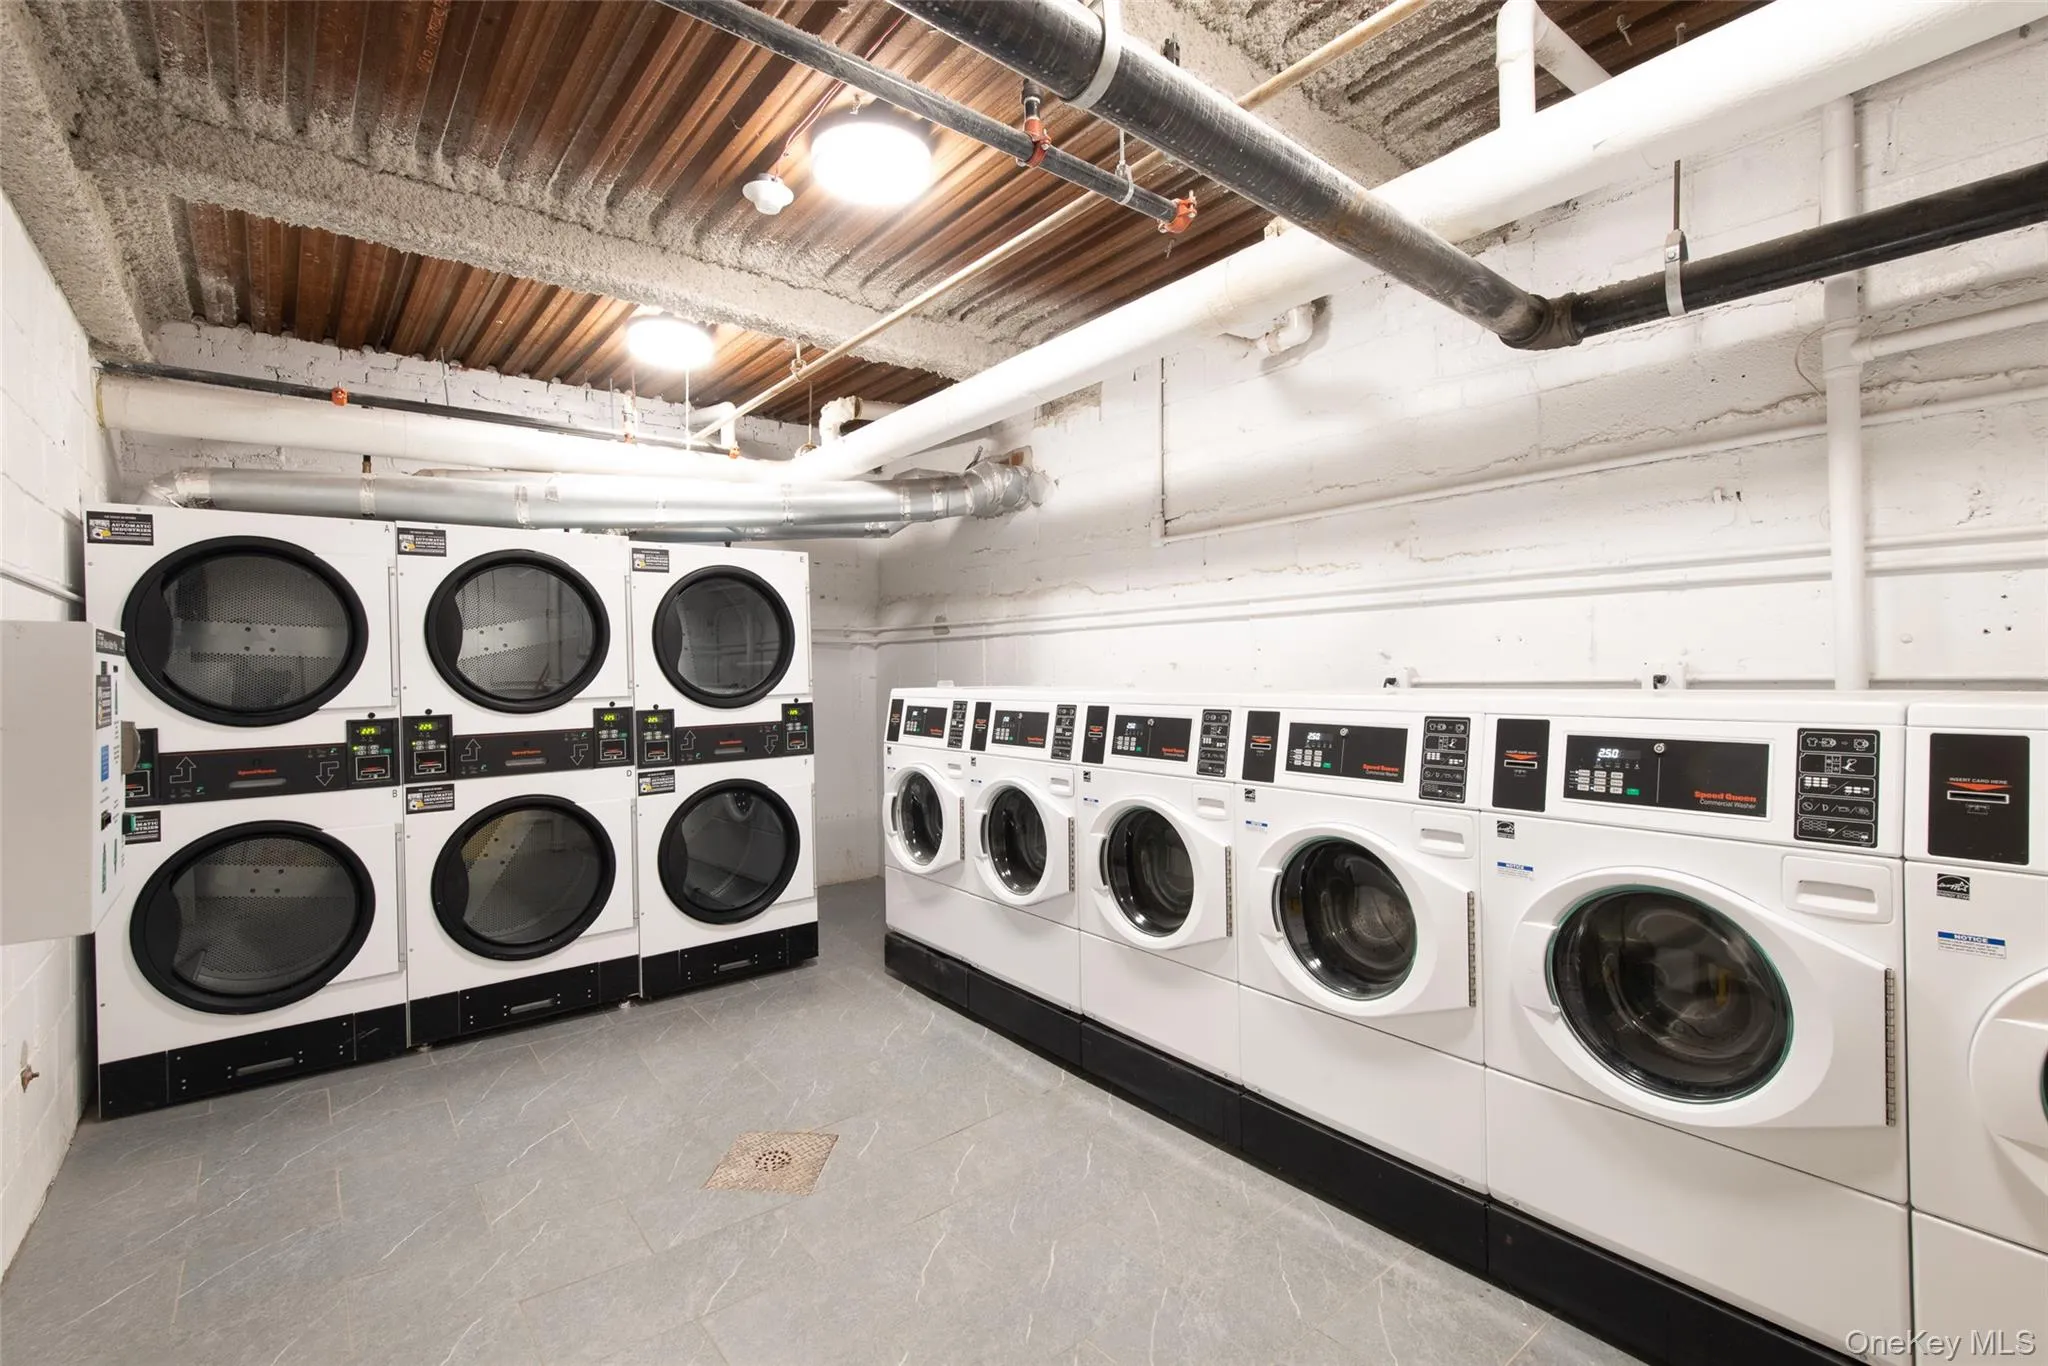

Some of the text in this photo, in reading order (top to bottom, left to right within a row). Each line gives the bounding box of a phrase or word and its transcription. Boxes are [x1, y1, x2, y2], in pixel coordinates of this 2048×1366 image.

[383, 524, 391, 534] A
[626, 768, 632, 777] D
[392, 789, 399, 798] B
[1694, 791, 1757, 802] Speed Queen
[1699, 799, 1733, 808] Commercial
[1954, 934, 1987, 943] NOTICE
